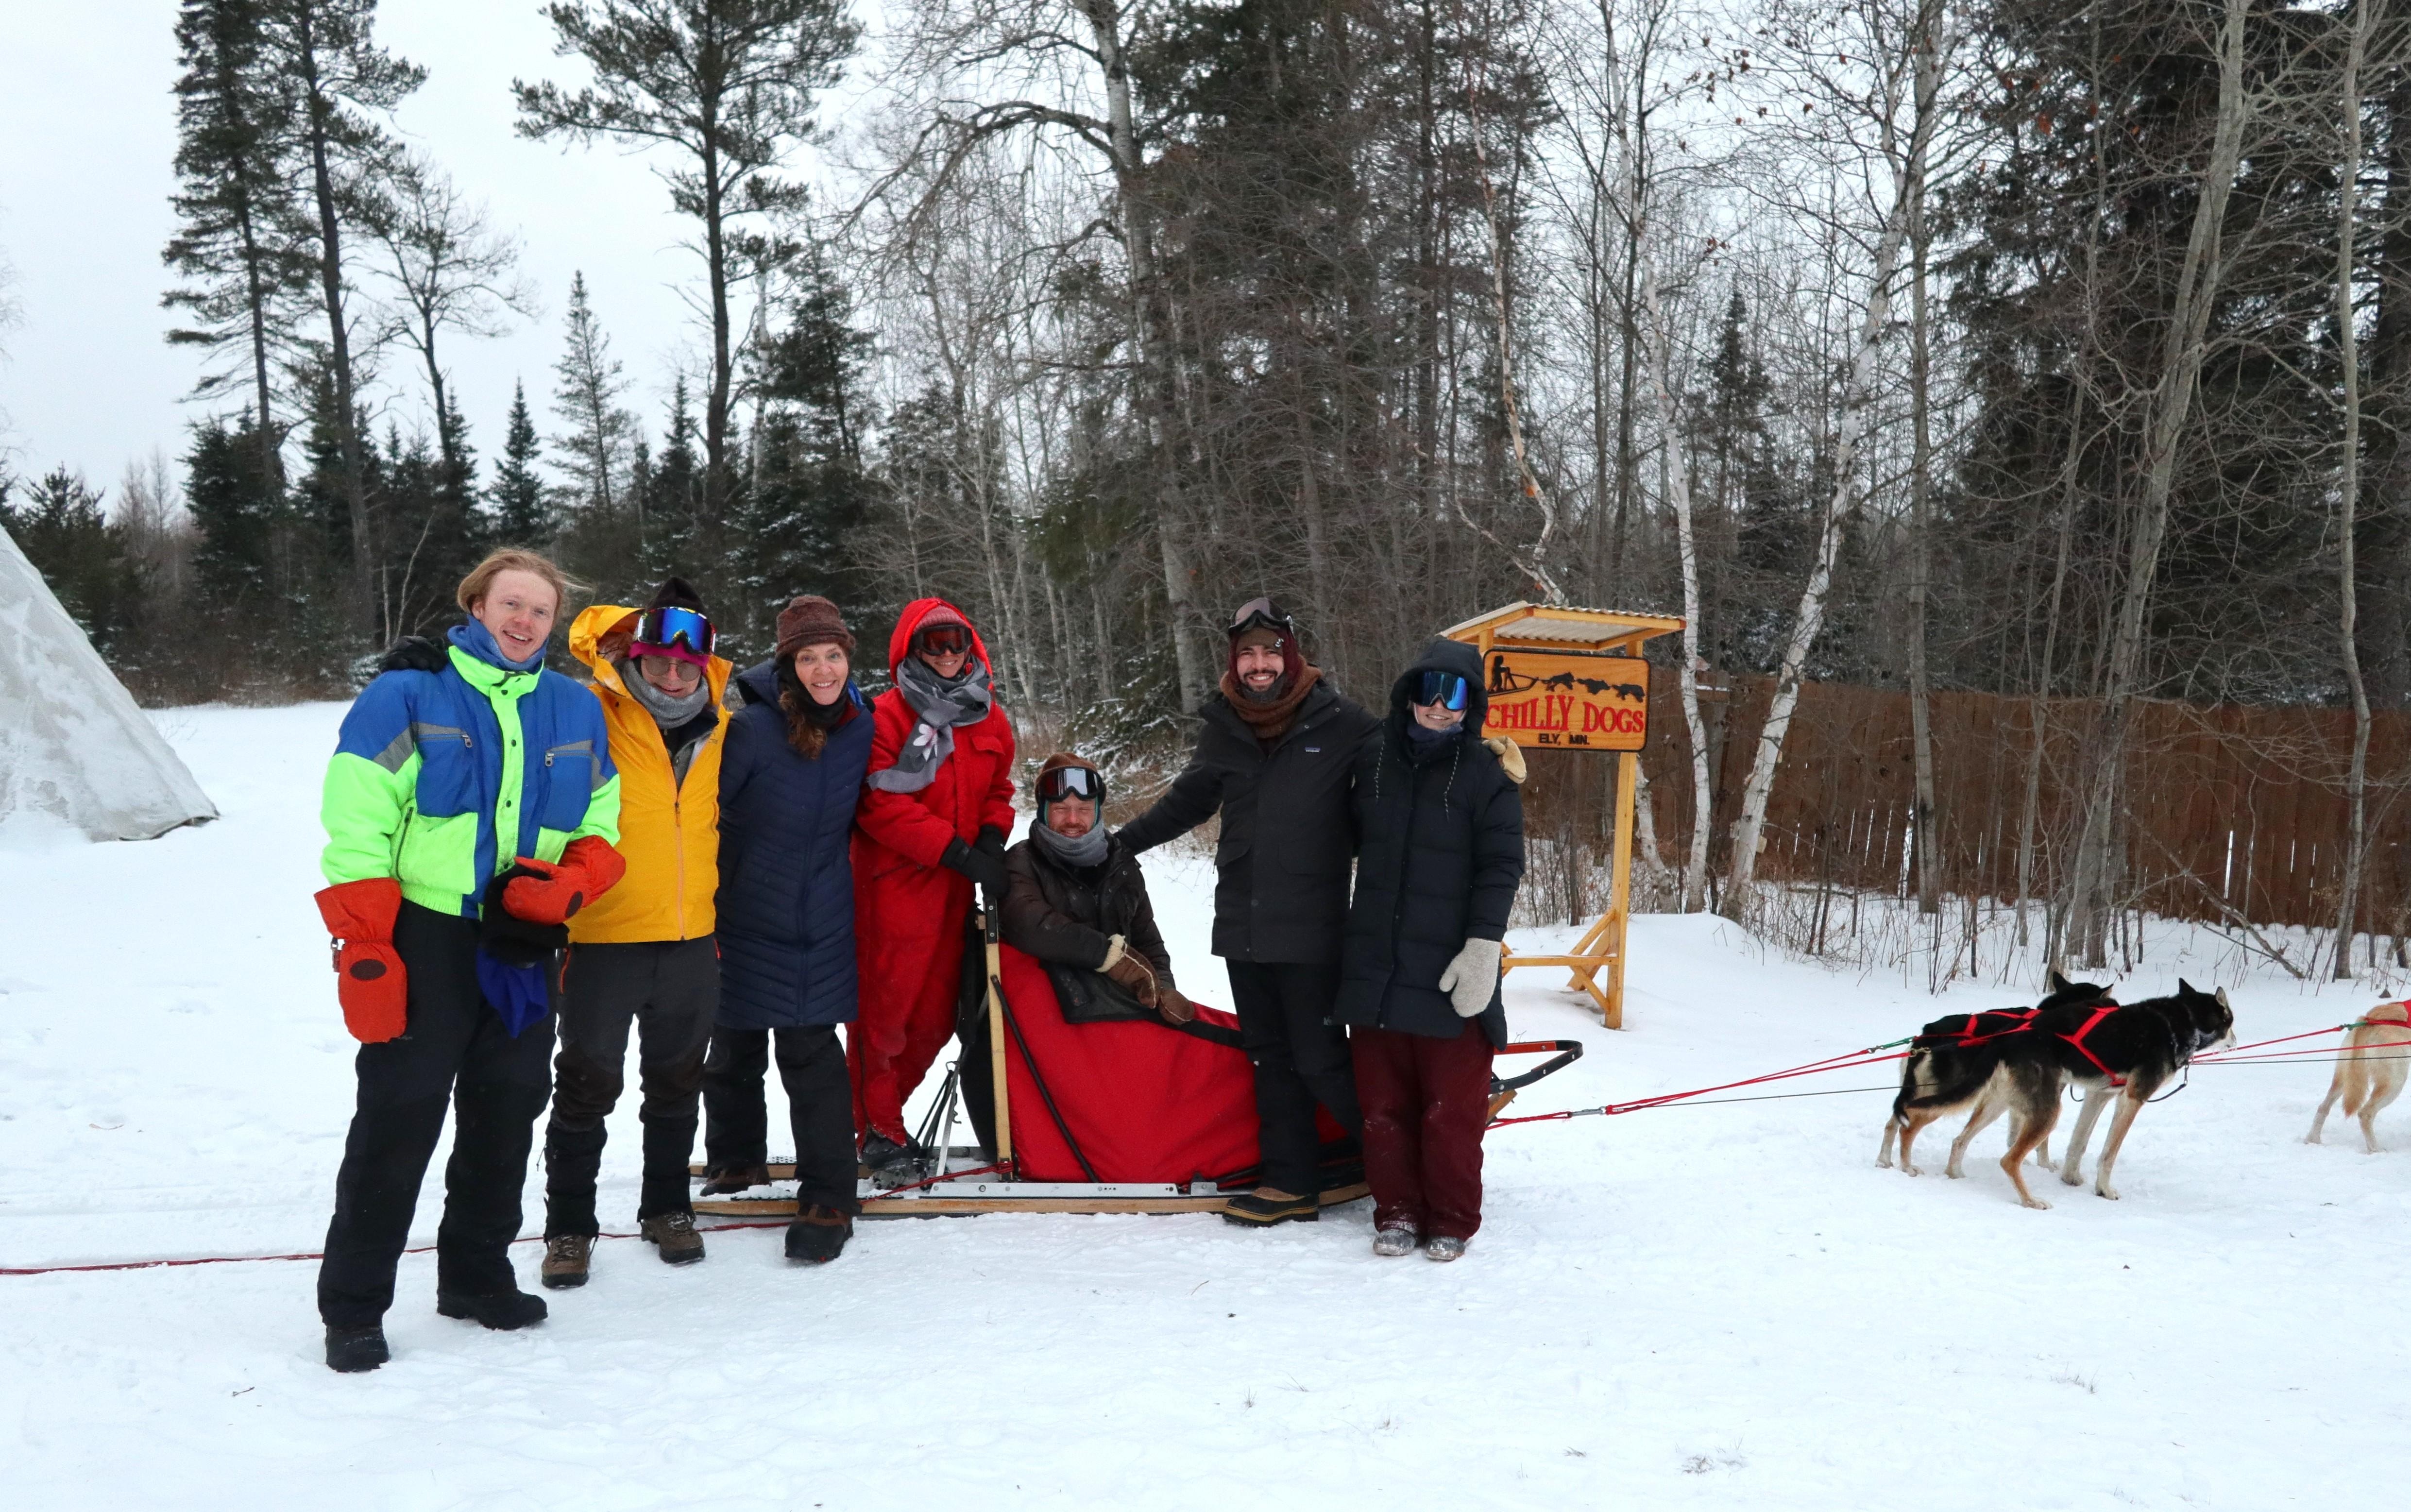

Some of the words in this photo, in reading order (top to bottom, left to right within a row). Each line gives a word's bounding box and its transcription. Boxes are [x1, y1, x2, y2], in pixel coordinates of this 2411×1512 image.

[1485, 695, 1575, 731] CHILLY
[1581, 701, 1644, 733] DOGS
[1539, 733, 1561, 746] ELY,
[1569, 734, 1590, 745] MN.
